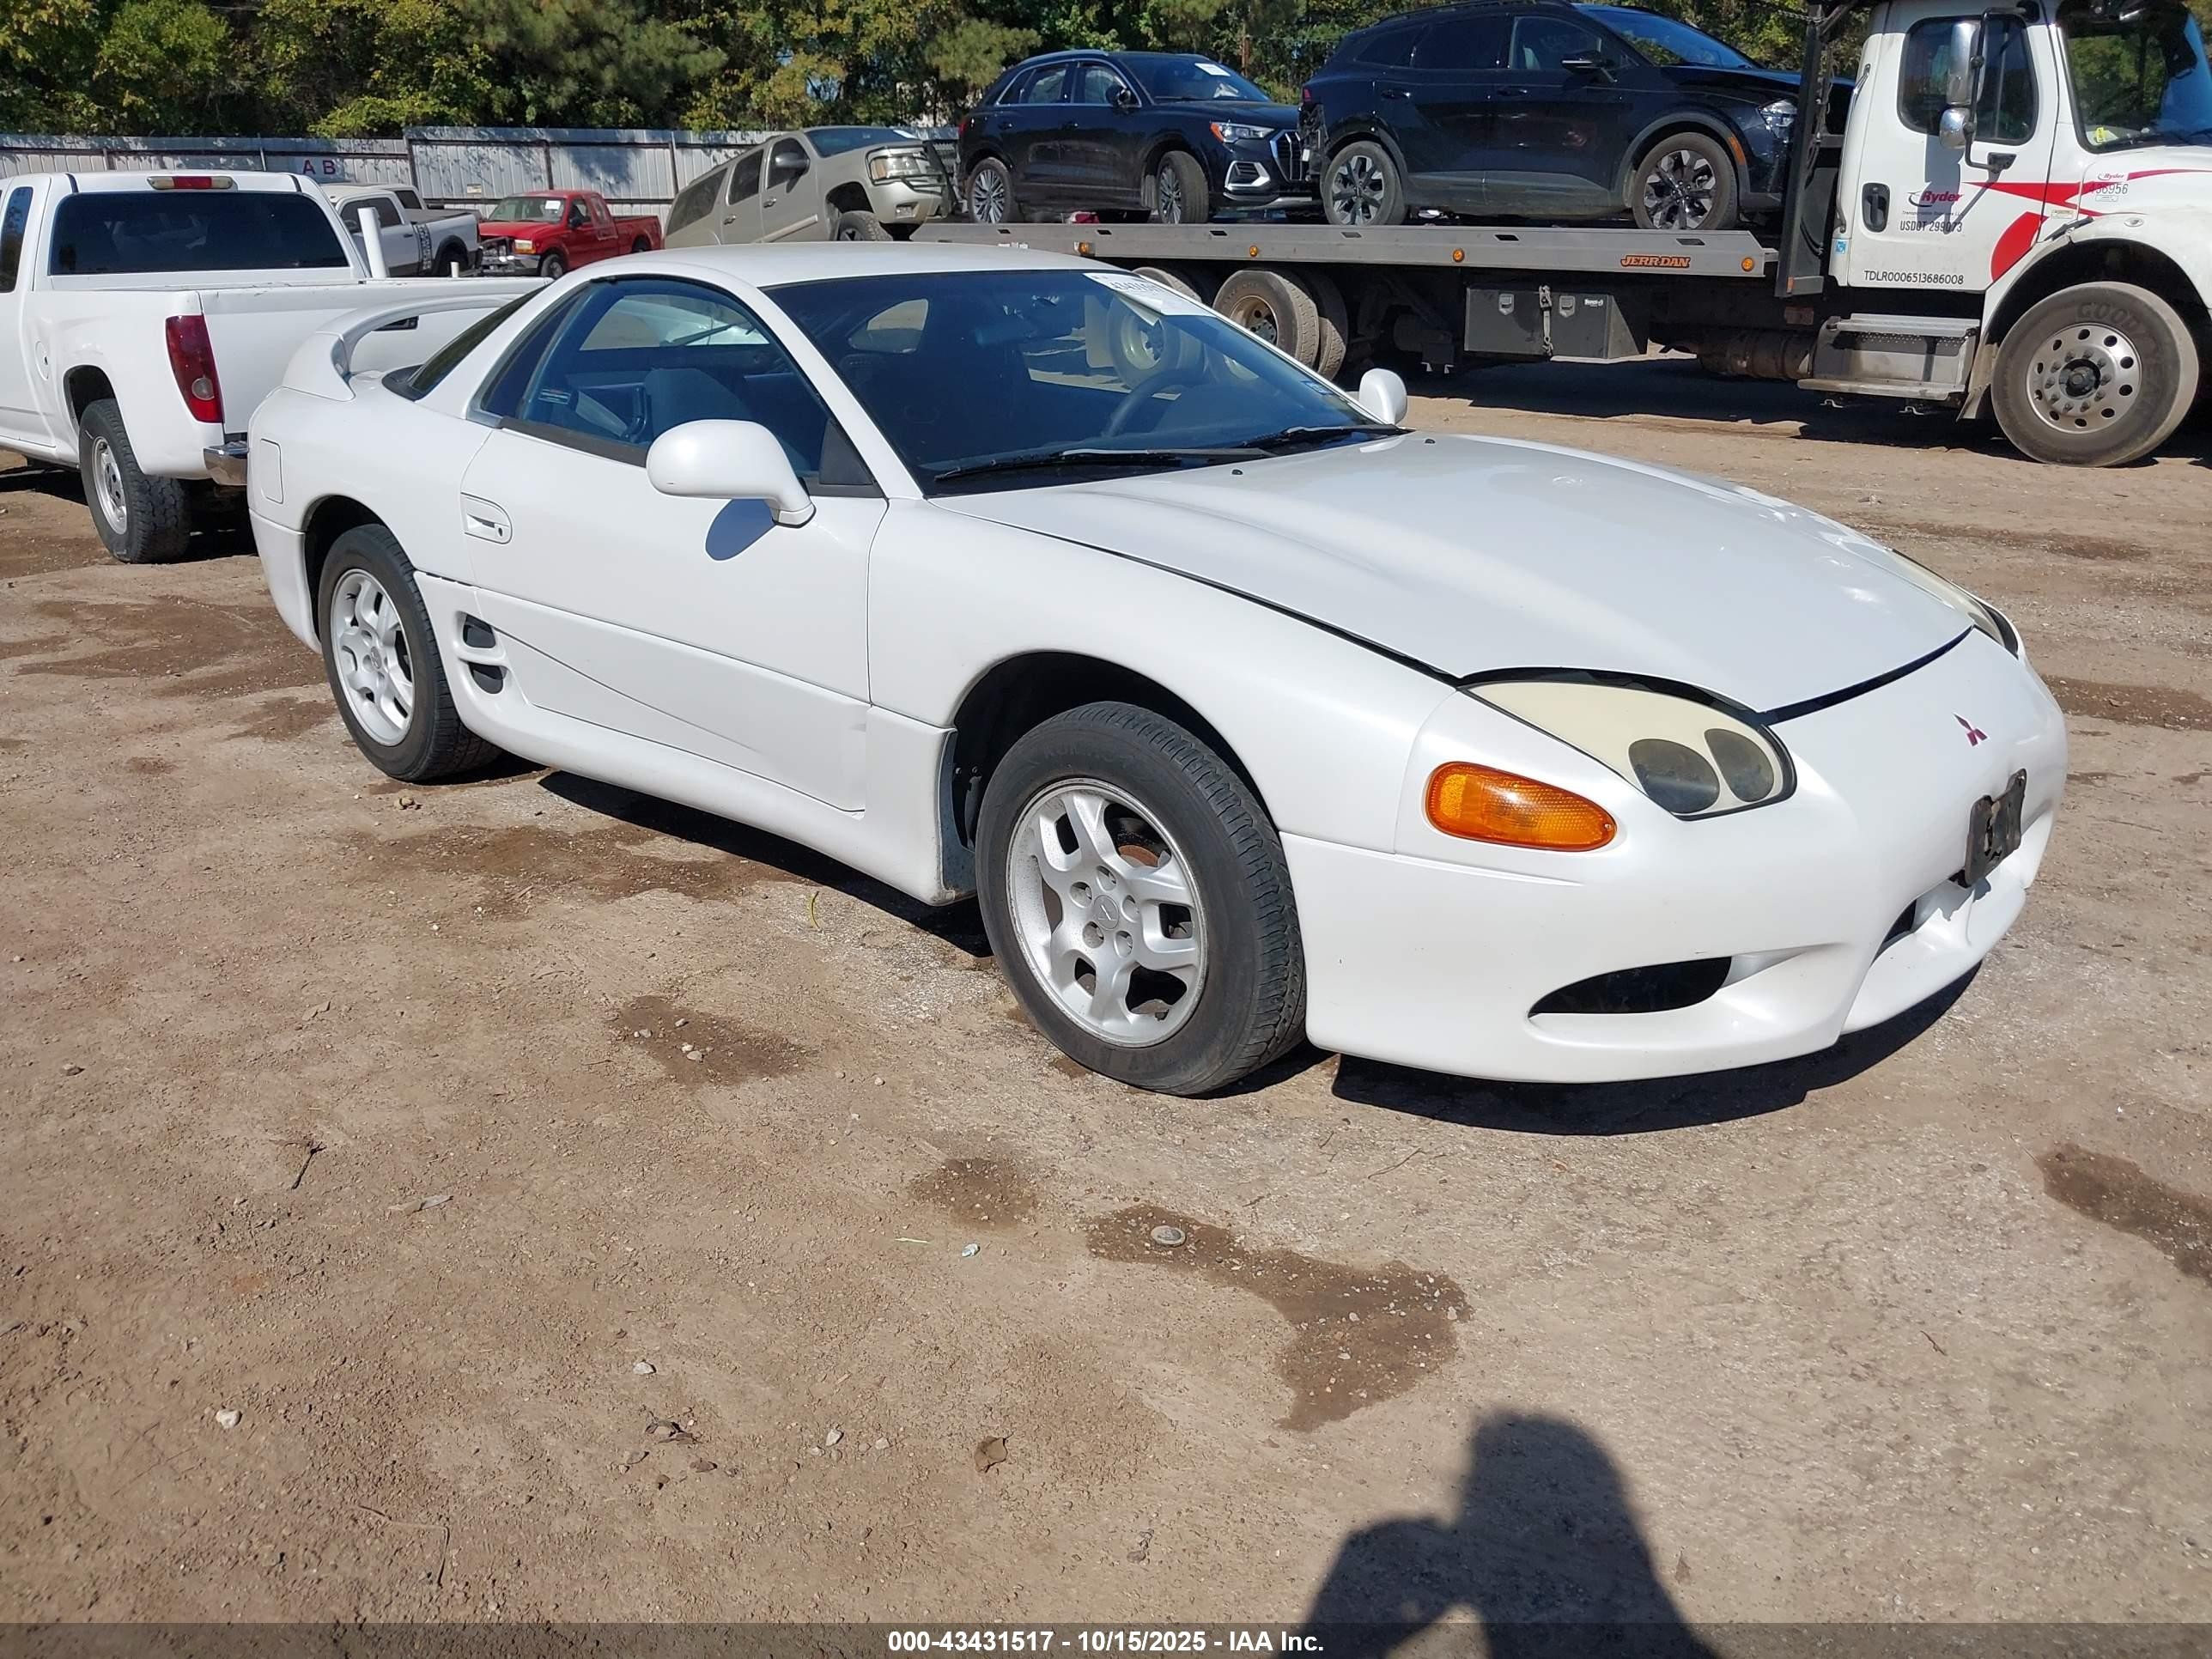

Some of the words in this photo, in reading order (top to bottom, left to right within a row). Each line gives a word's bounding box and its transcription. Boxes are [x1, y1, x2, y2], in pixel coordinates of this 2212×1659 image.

[303, 160, 316, 174] A
[323, 160, 336, 174] B
[1921, 191, 1964, 204] Ryder
[1899, 220, 1928, 232] USDOT
[1929, 220, 1964, 233] 299073
[1863, 270, 1964, 284] TDLR0006513686008
